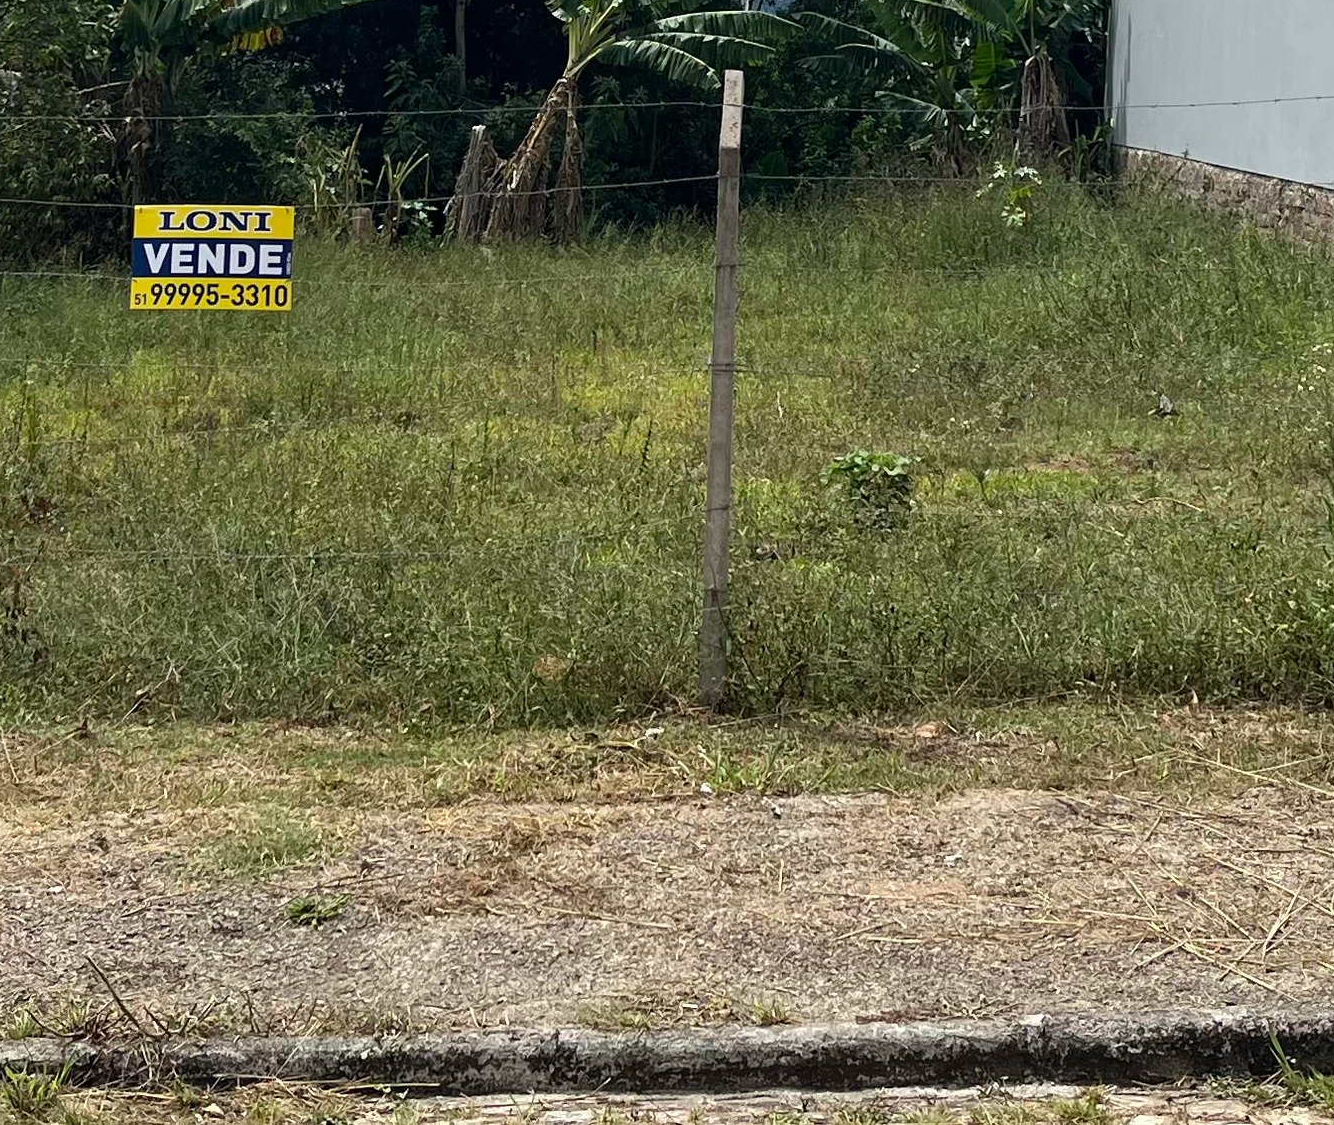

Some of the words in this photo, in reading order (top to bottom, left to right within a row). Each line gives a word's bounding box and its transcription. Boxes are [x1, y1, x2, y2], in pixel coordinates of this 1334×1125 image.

[158, 210, 272, 232] LONI
[143, 243, 284, 275] VENDE
[134, 293, 147, 306] 51
[150, 283, 288, 307] 99995-3310
